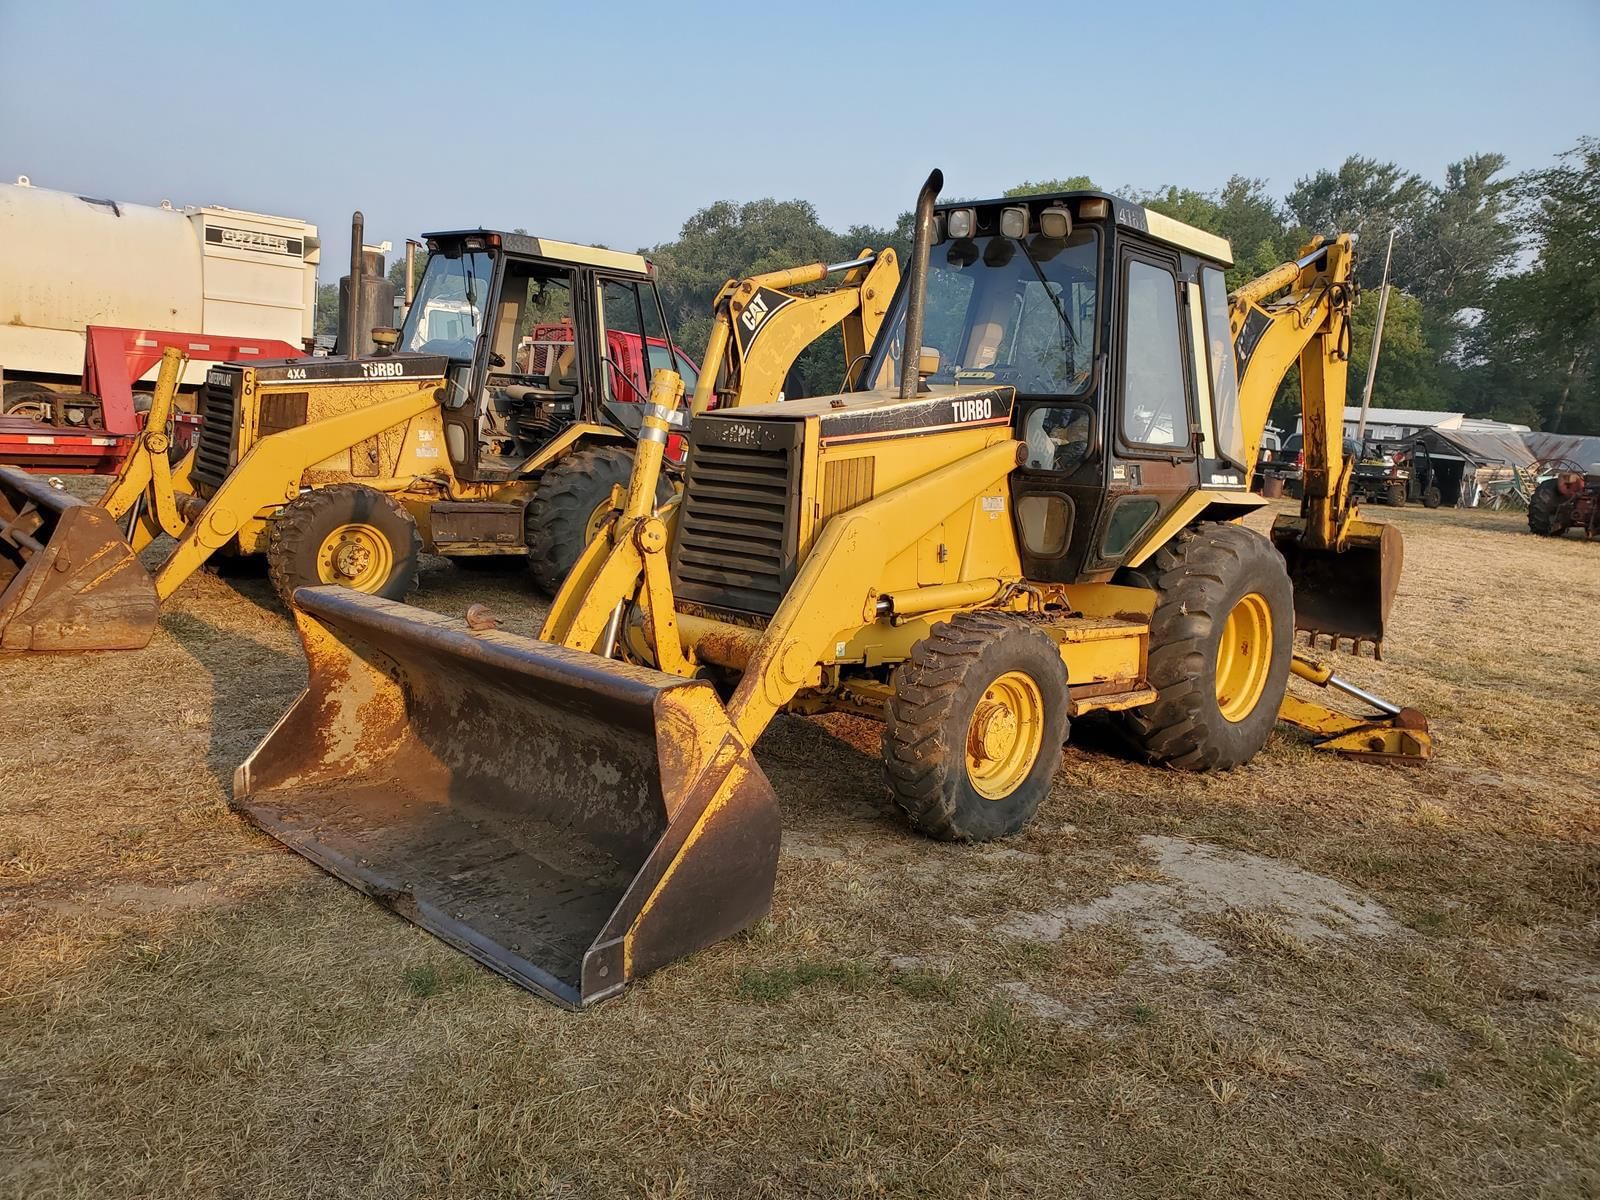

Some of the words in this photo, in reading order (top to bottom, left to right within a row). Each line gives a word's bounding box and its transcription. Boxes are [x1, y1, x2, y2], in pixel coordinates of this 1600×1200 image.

[741, 292, 769, 331] CAT
[287, 368, 307, 379] 4X4
[361, 362, 404, 377] TURBO
[951, 398, 992, 423] TURBO
